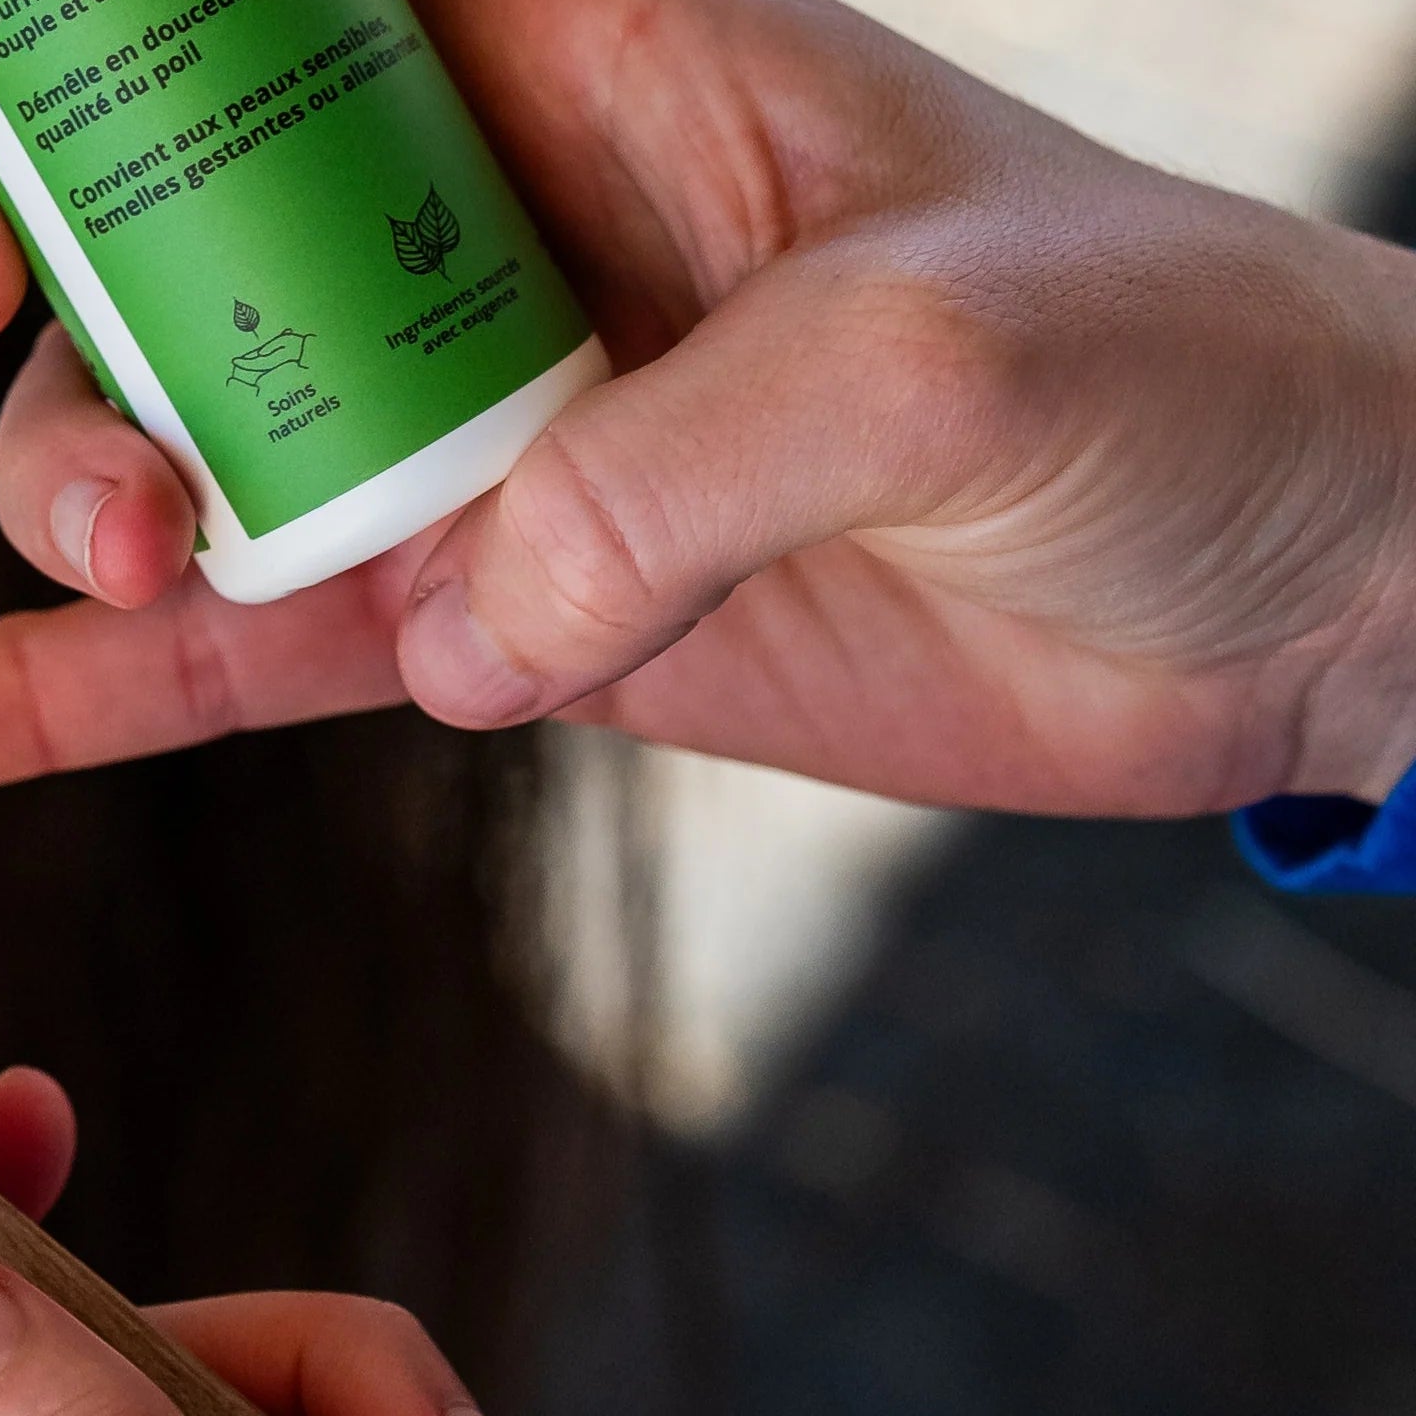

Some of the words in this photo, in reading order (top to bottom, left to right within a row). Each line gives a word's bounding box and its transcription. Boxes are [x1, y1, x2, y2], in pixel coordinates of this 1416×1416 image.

[16, 63, 103, 123] Démêle
[106, 44, 139, 73] en
[35, 90, 113, 153] qualité
[115, 66, 150, 106] du
[155, 41, 205, 88] poil
[69, 142, 171, 211] Convient
[173, 114, 223, 155] aux
[223, 68, 303, 123] peaux
[84, 173, 181, 239] femelles
[183, 105, 306, 190] gestantes
[308, 84, 340, 111] ou
[384, 288, 476, 350] Ingrédients
[422, 324, 461, 355] avec
[461, 287, 519, 331] exigence
[267, 383, 317, 418] Soins
[267, 394, 342, 444] naturels
